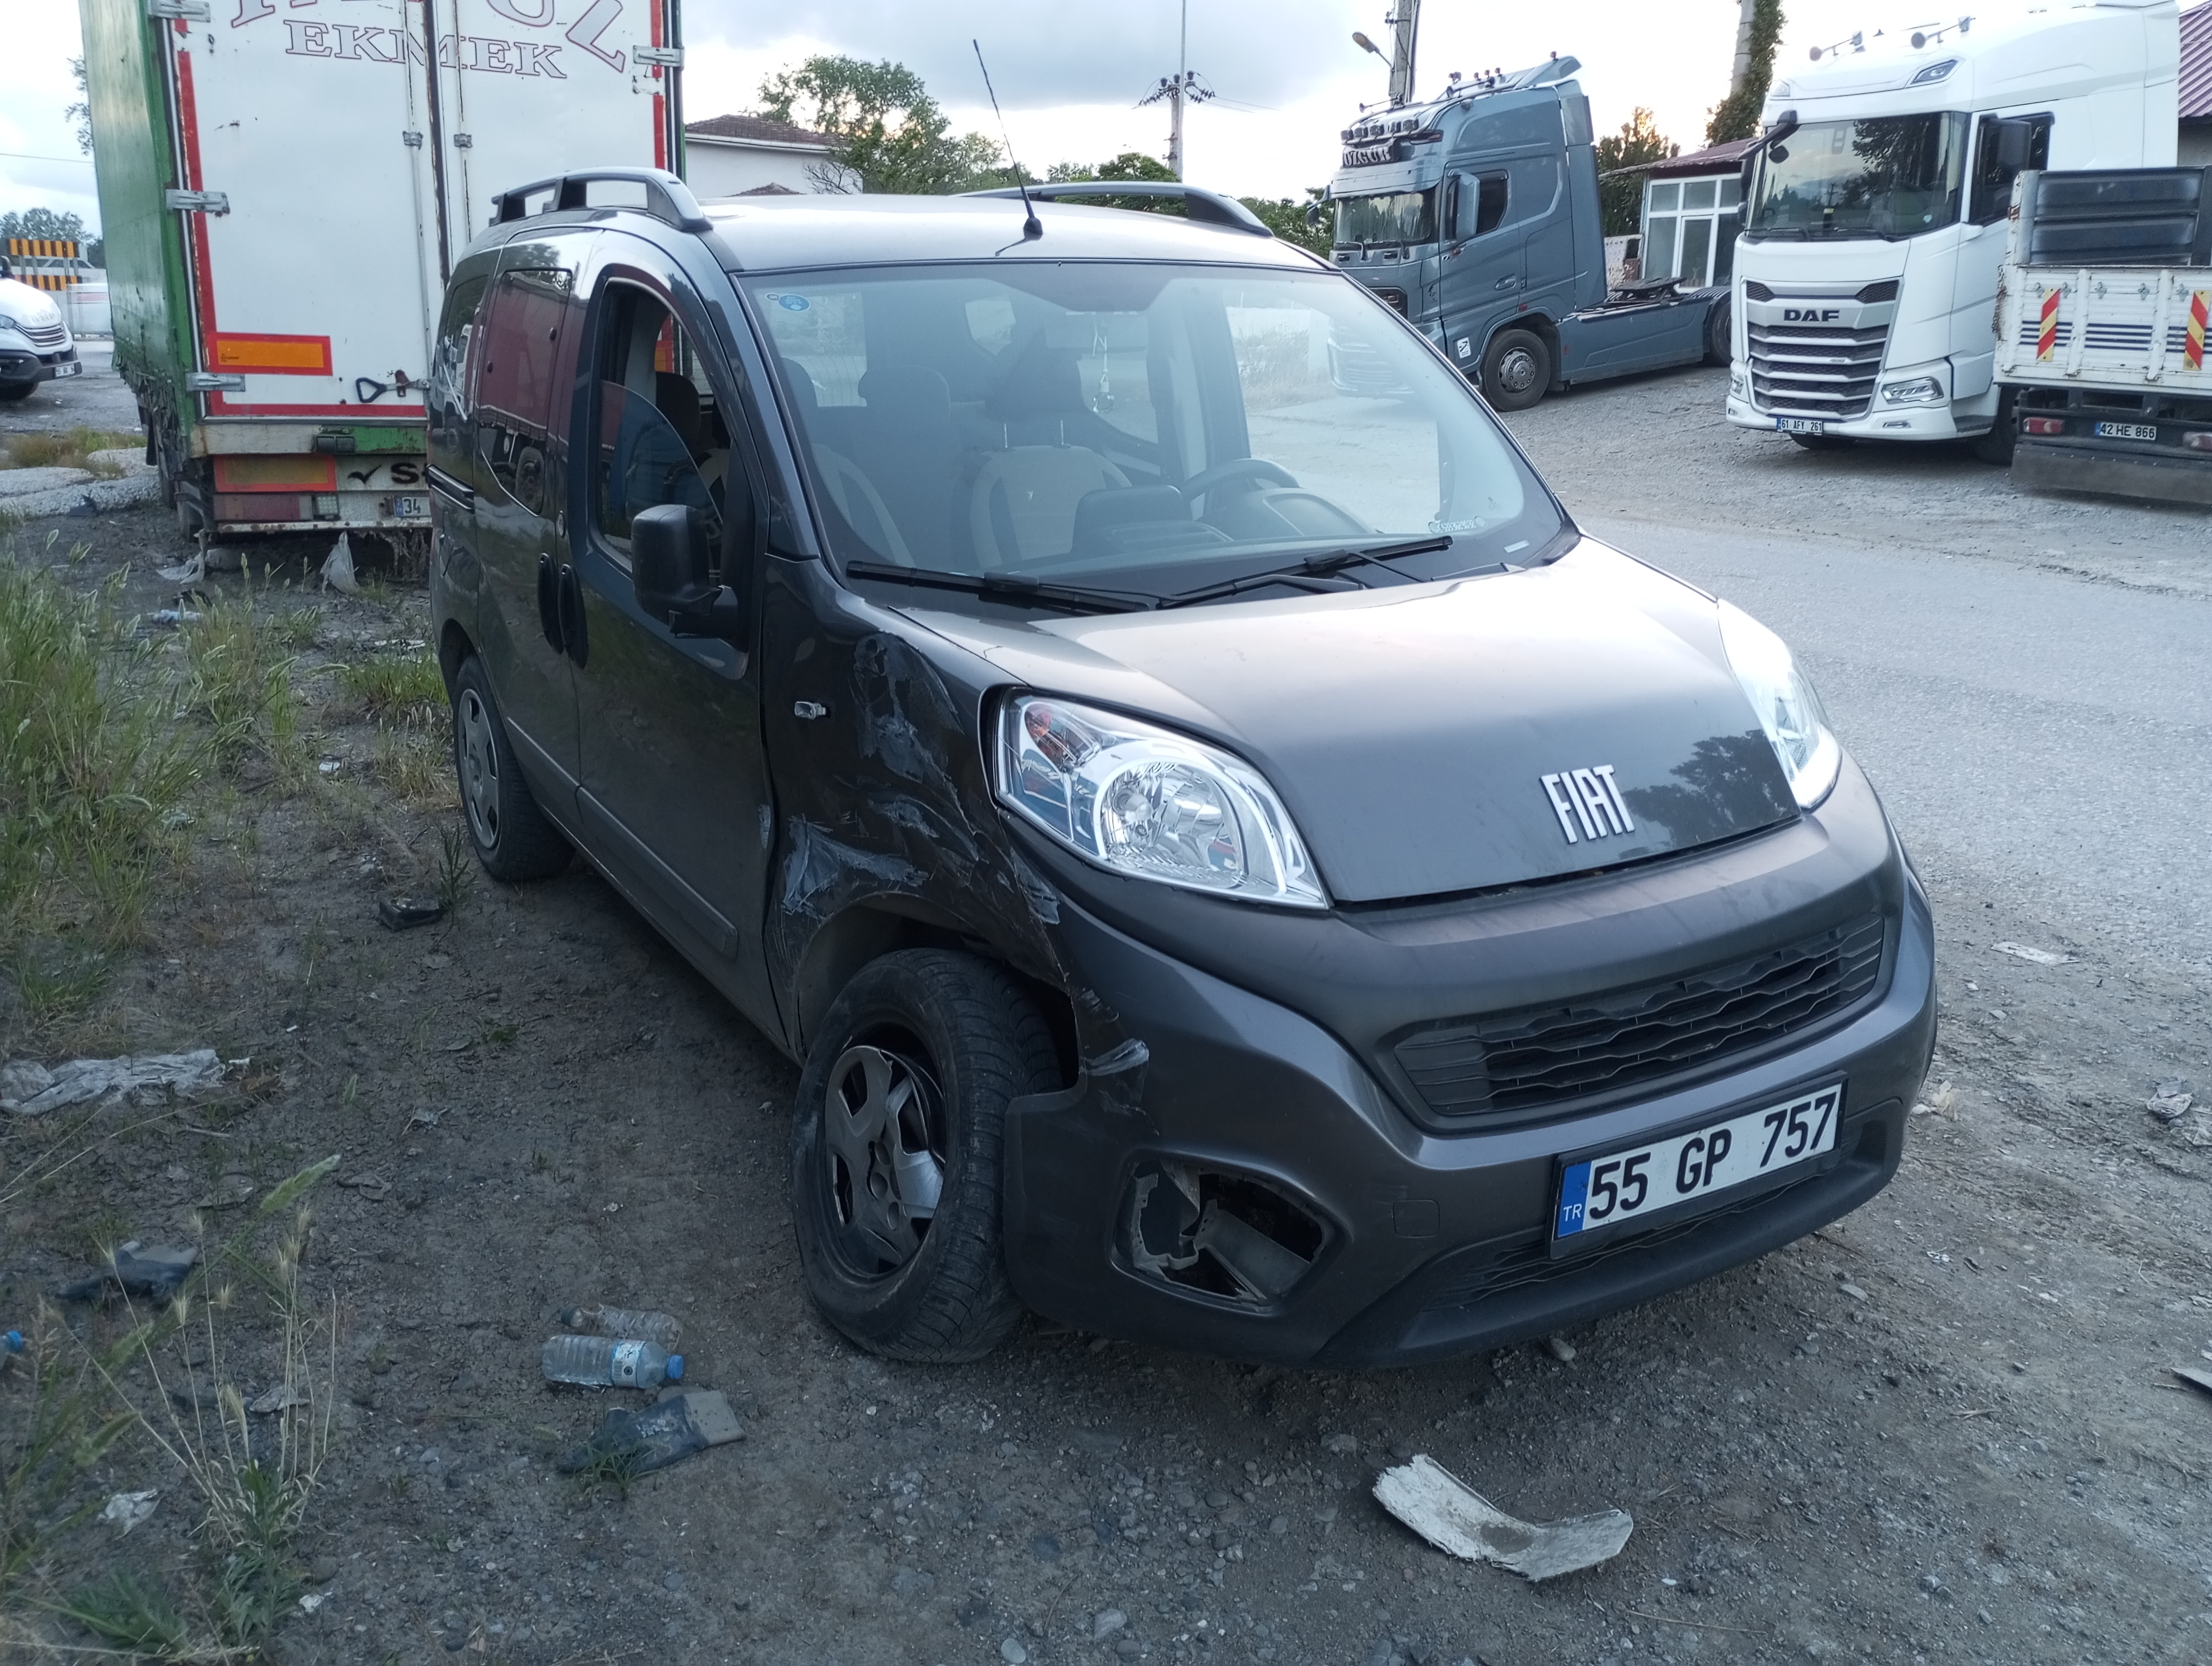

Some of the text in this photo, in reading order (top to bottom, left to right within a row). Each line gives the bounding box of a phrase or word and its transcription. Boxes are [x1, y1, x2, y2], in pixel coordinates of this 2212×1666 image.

[283, 20, 567, 79] EKMEK
[1783, 309, 1840, 322] DAF
[1782, 419, 1821, 431] 61 AFY 261
[2100, 424, 2155, 438] 42 HE 866
[403, 498, 421, 514] 34
[1539, 764, 1635, 844] FIAT
[1563, 1092, 1837, 1222] TR 55 GP 757
